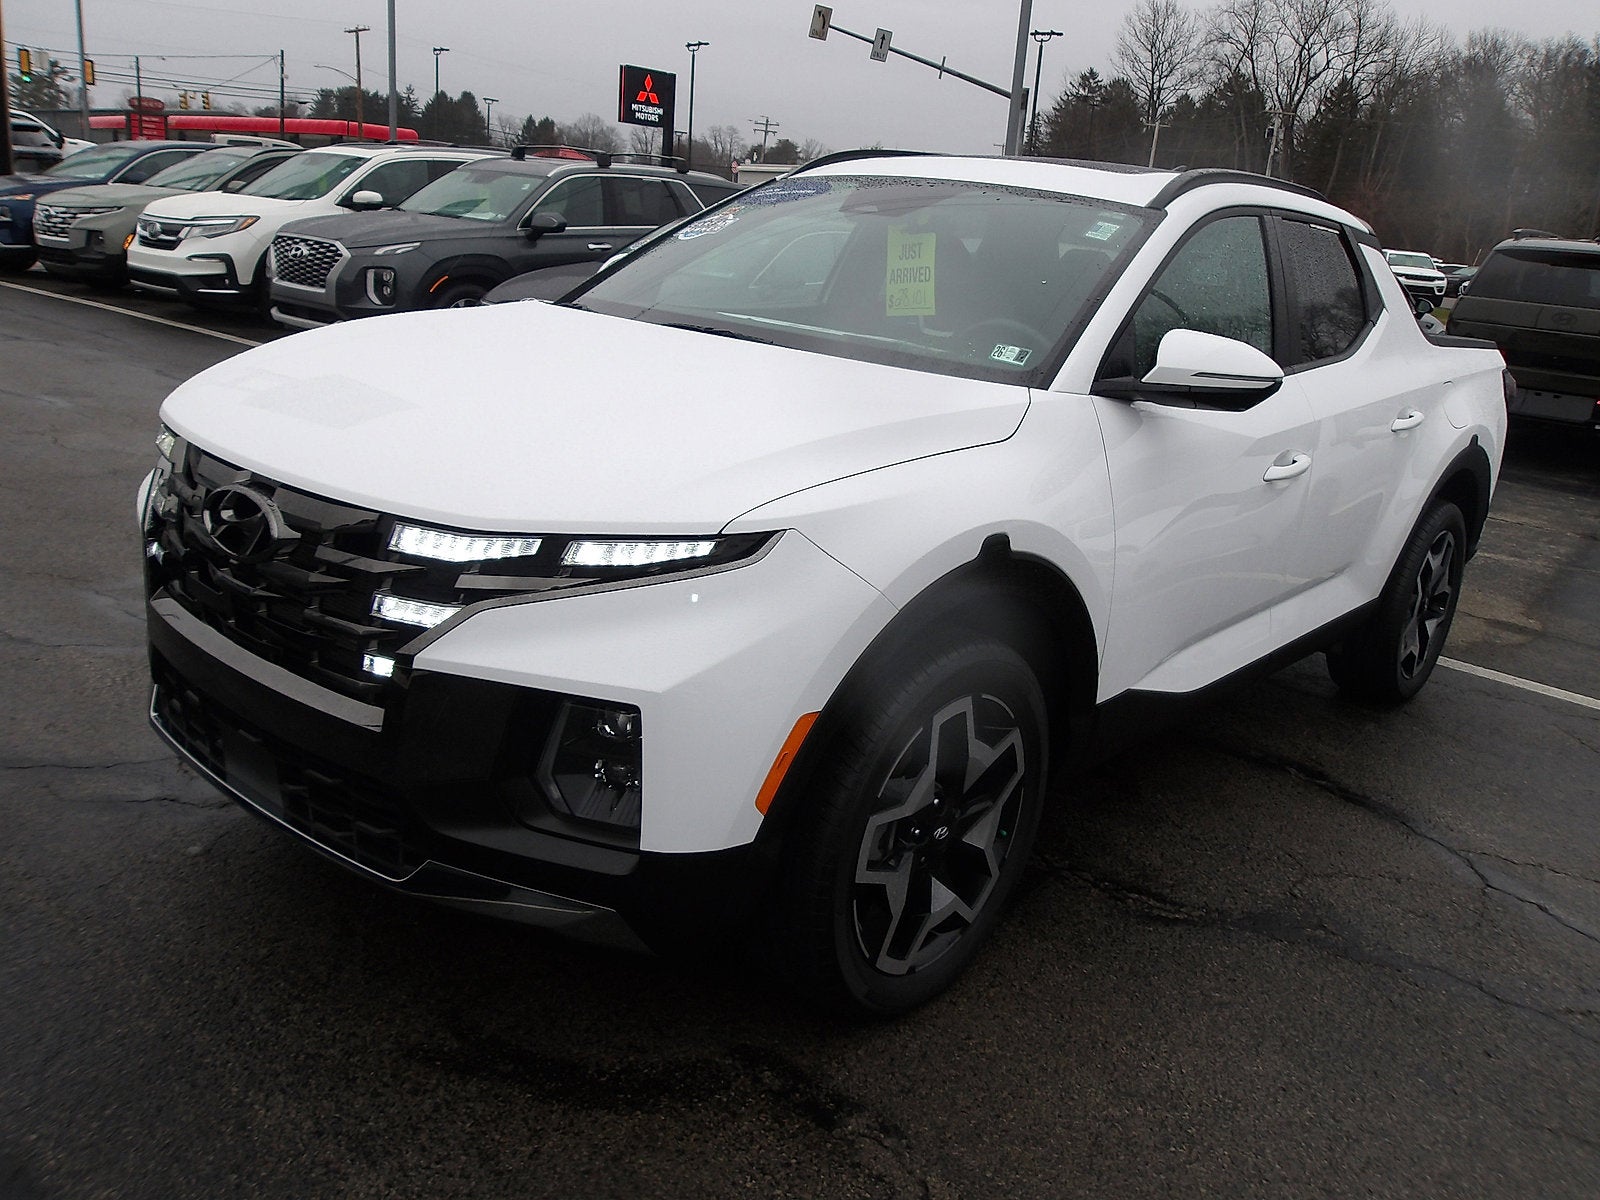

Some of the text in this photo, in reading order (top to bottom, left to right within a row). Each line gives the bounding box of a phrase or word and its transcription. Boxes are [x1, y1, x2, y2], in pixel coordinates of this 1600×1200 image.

[631, 104, 663, 115] MITSUBISHI
[635, 112, 659, 122] MOTORS
[898, 242, 923, 261] JUST
[889, 265, 931, 285] ARRIVED
[992, 345, 1006, 358] 26
